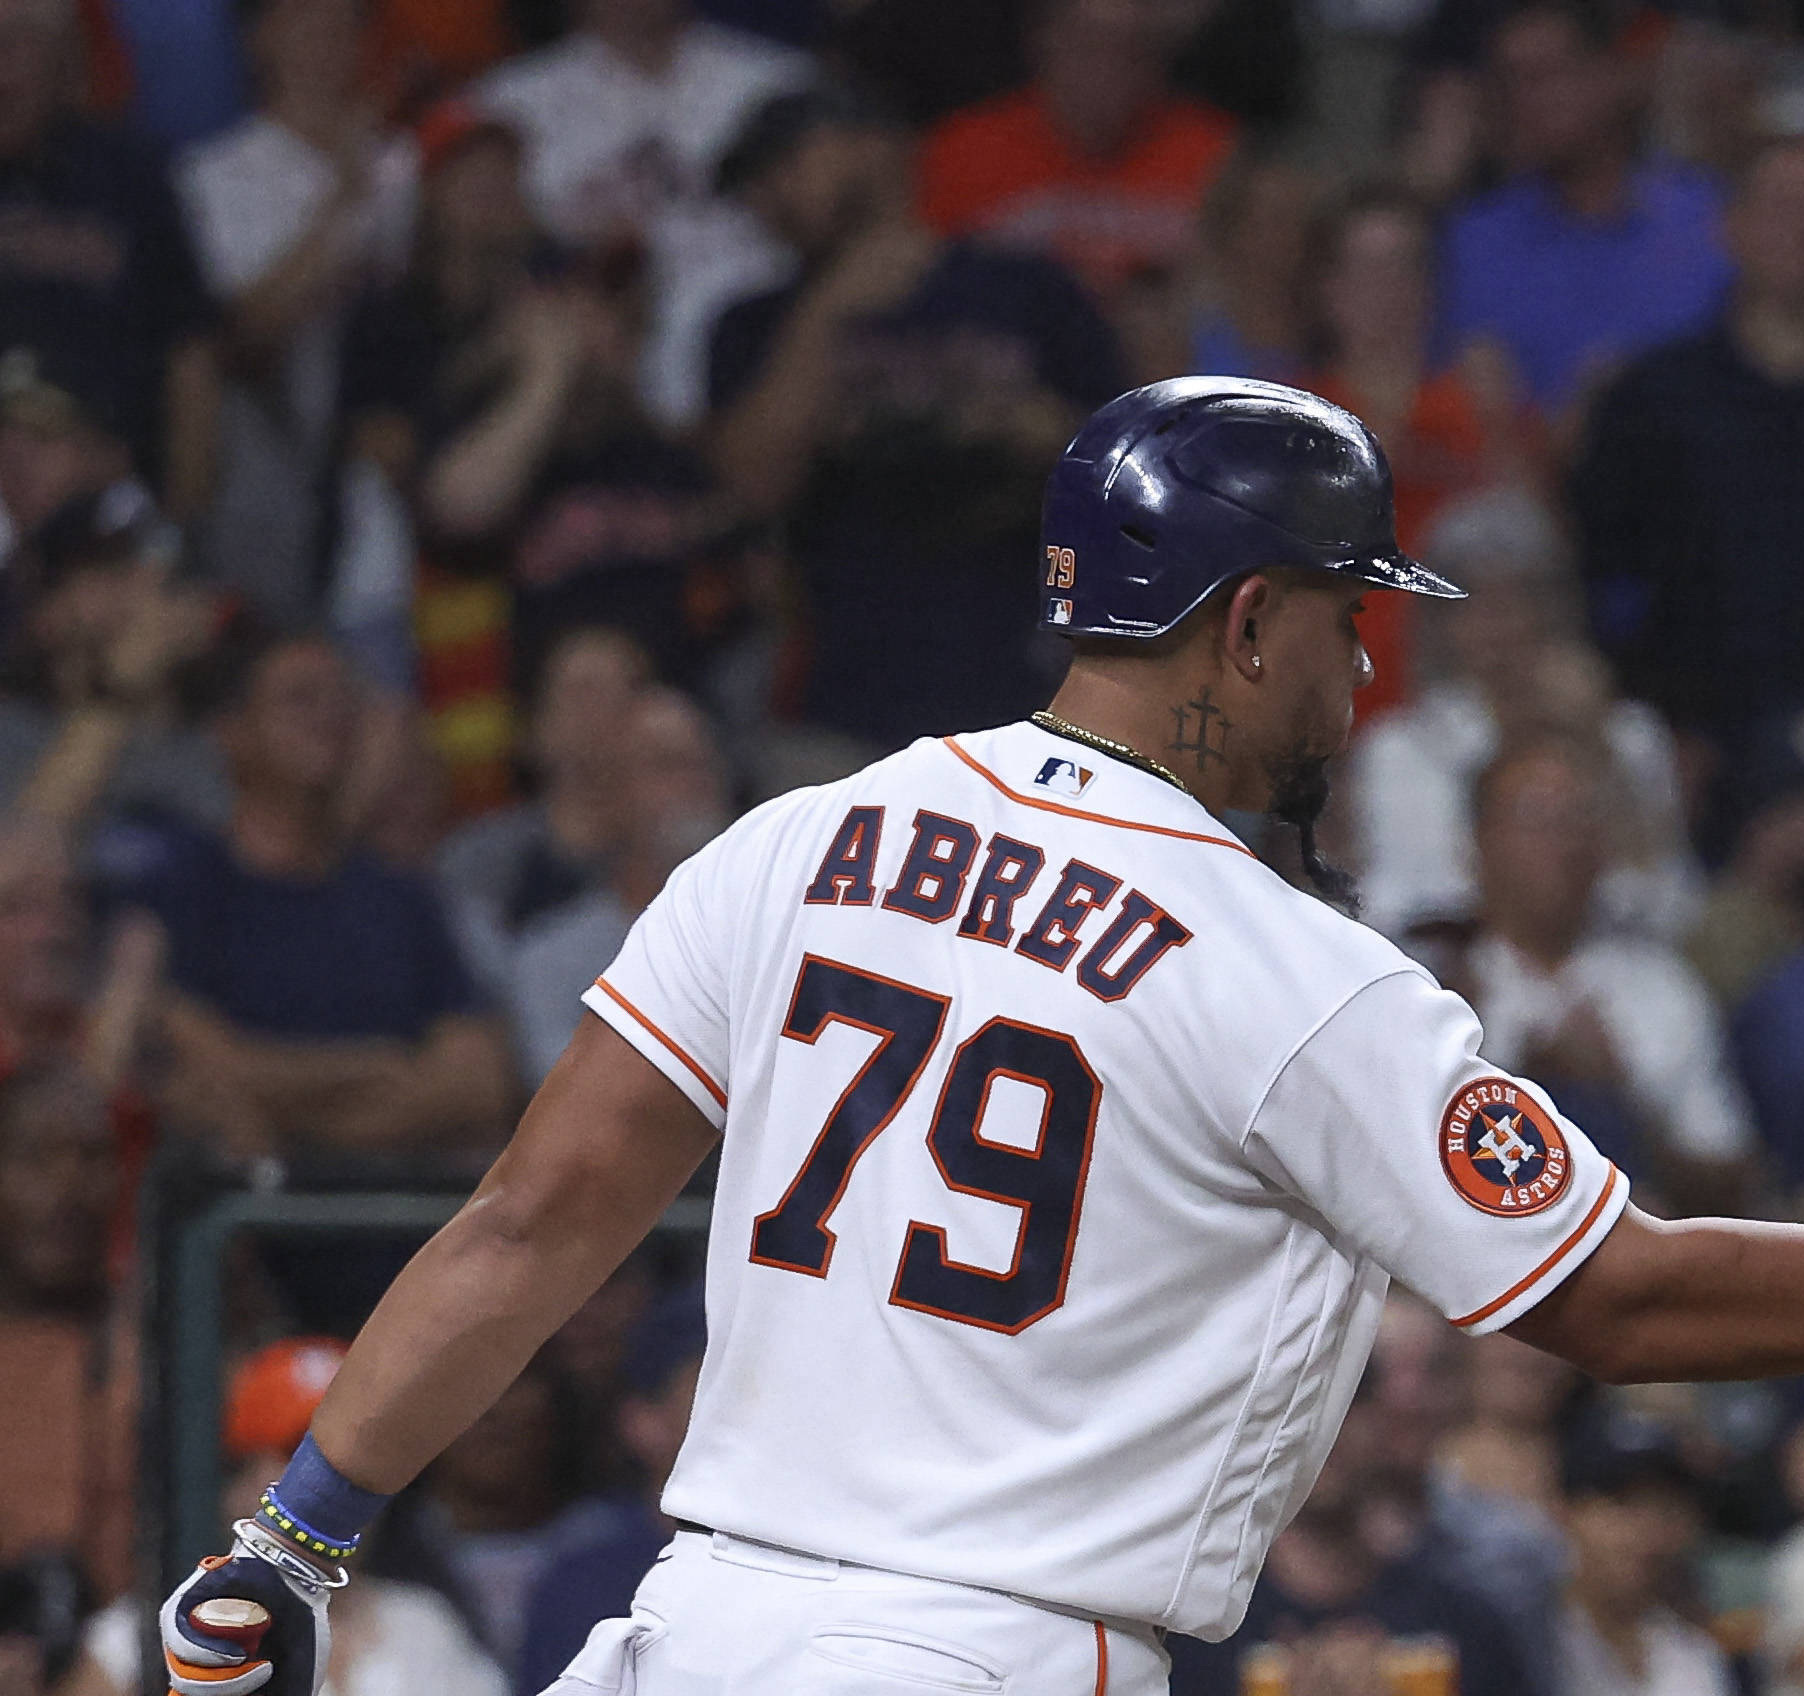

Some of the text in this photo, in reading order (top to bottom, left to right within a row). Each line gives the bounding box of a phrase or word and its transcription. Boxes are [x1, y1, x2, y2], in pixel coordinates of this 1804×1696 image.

[1046, 546, 1076, 589] 79
[804, 805, 1194, 1003] ABREU
[748, 952, 1103, 1335] 79
[1448, 1084, 1517, 1153] HOUSTON
[1501, 1147, 1564, 1206] ASTROS
